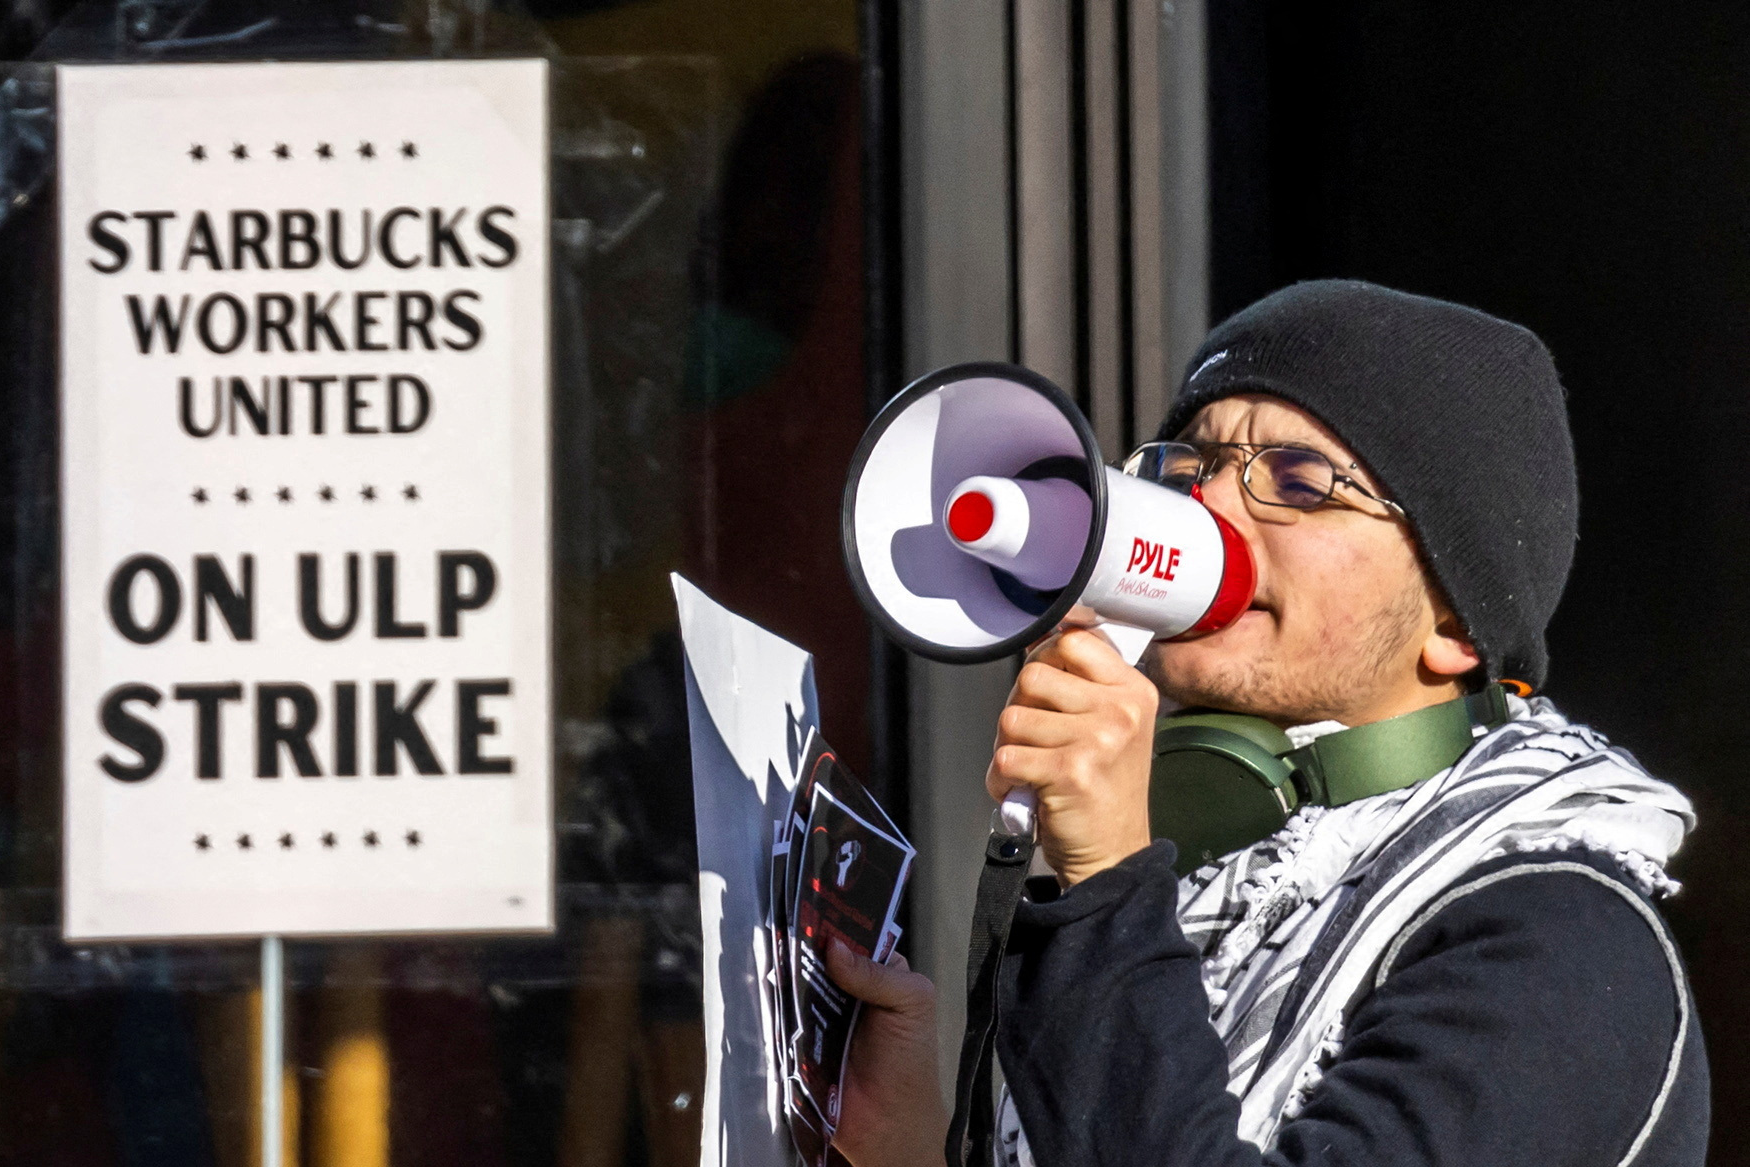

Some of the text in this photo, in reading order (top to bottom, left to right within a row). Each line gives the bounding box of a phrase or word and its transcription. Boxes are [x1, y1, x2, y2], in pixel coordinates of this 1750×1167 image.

[87, 205, 519, 274] STARBUCKS
[124, 289, 485, 354] WORKERS
[178, 373, 435, 438] UNITED
[1126, 536, 1181, 582] PYLE
[107, 549, 501, 645] ON ULP
[97, 677, 517, 784] STRIKE
